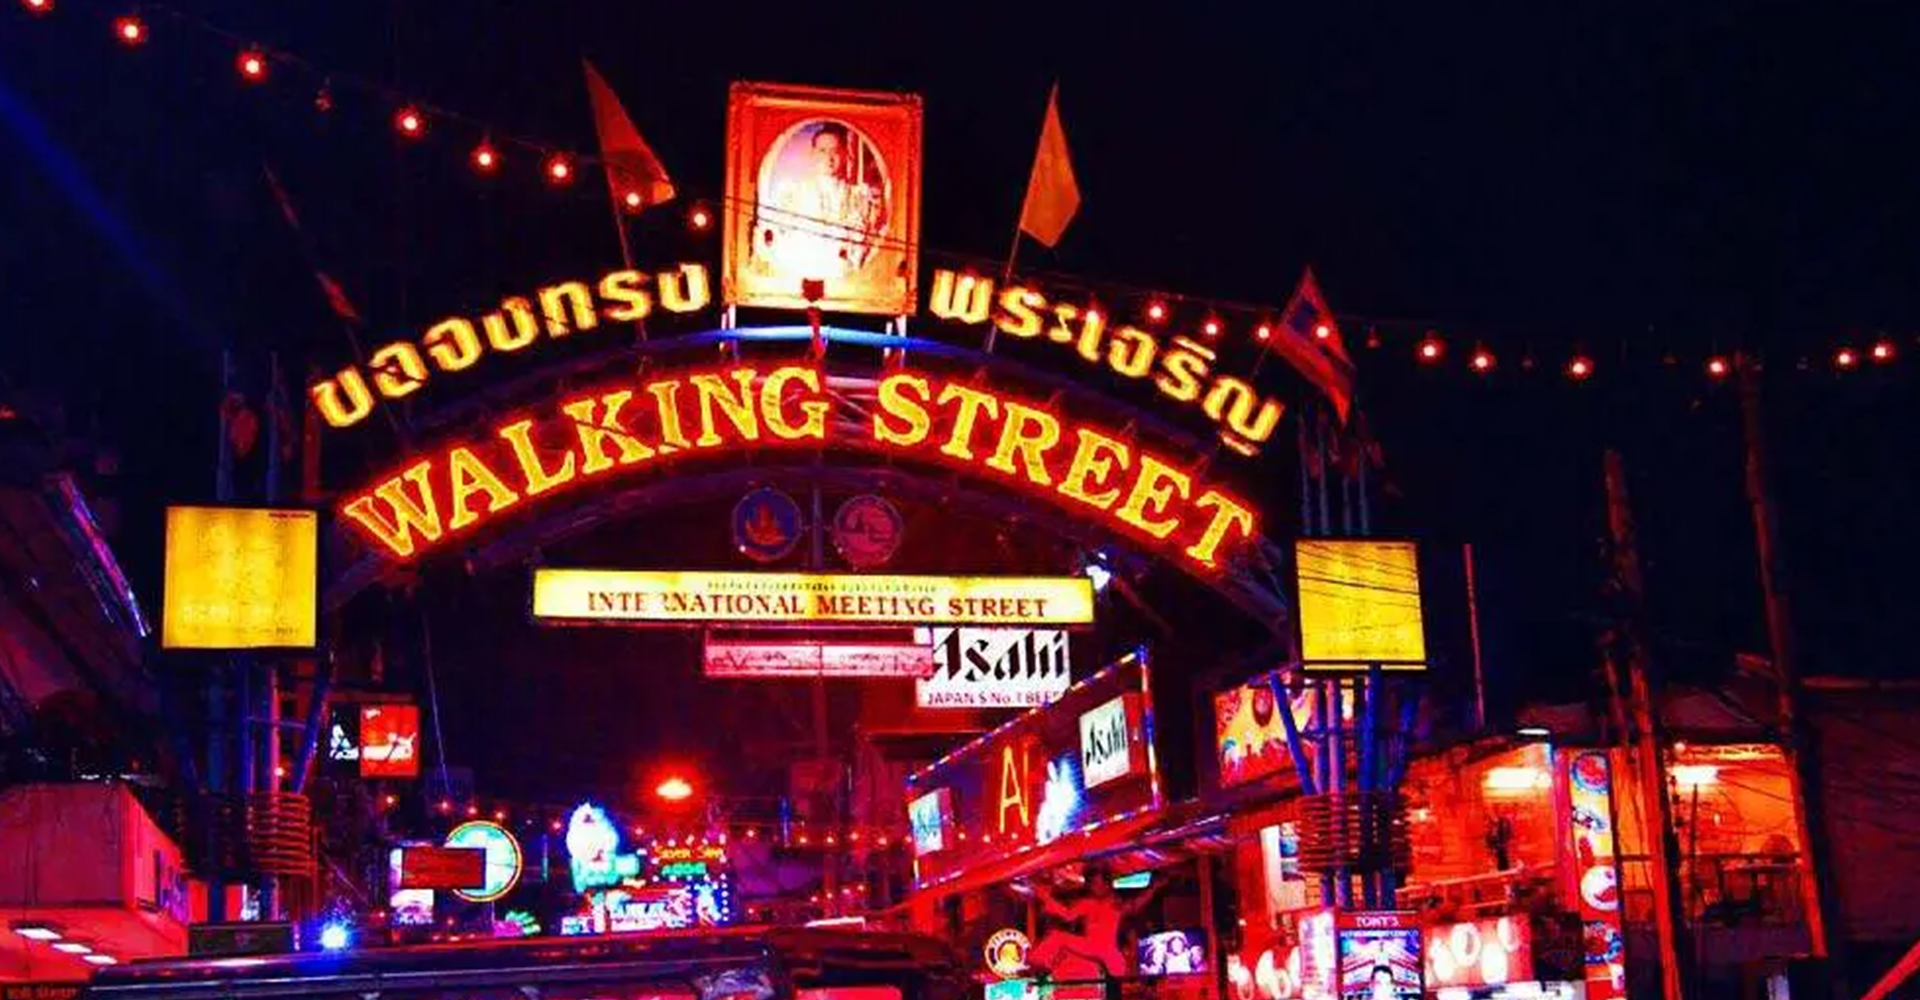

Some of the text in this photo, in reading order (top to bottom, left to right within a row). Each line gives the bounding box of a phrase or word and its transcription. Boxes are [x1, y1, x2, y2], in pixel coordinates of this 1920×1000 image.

[343, 368, 1253, 567] WALKING STREET
[816, 595, 935, 616] MEETING
[949, 598, 1049, 618] STREET
[931, 627, 1066, 681] Asahi
